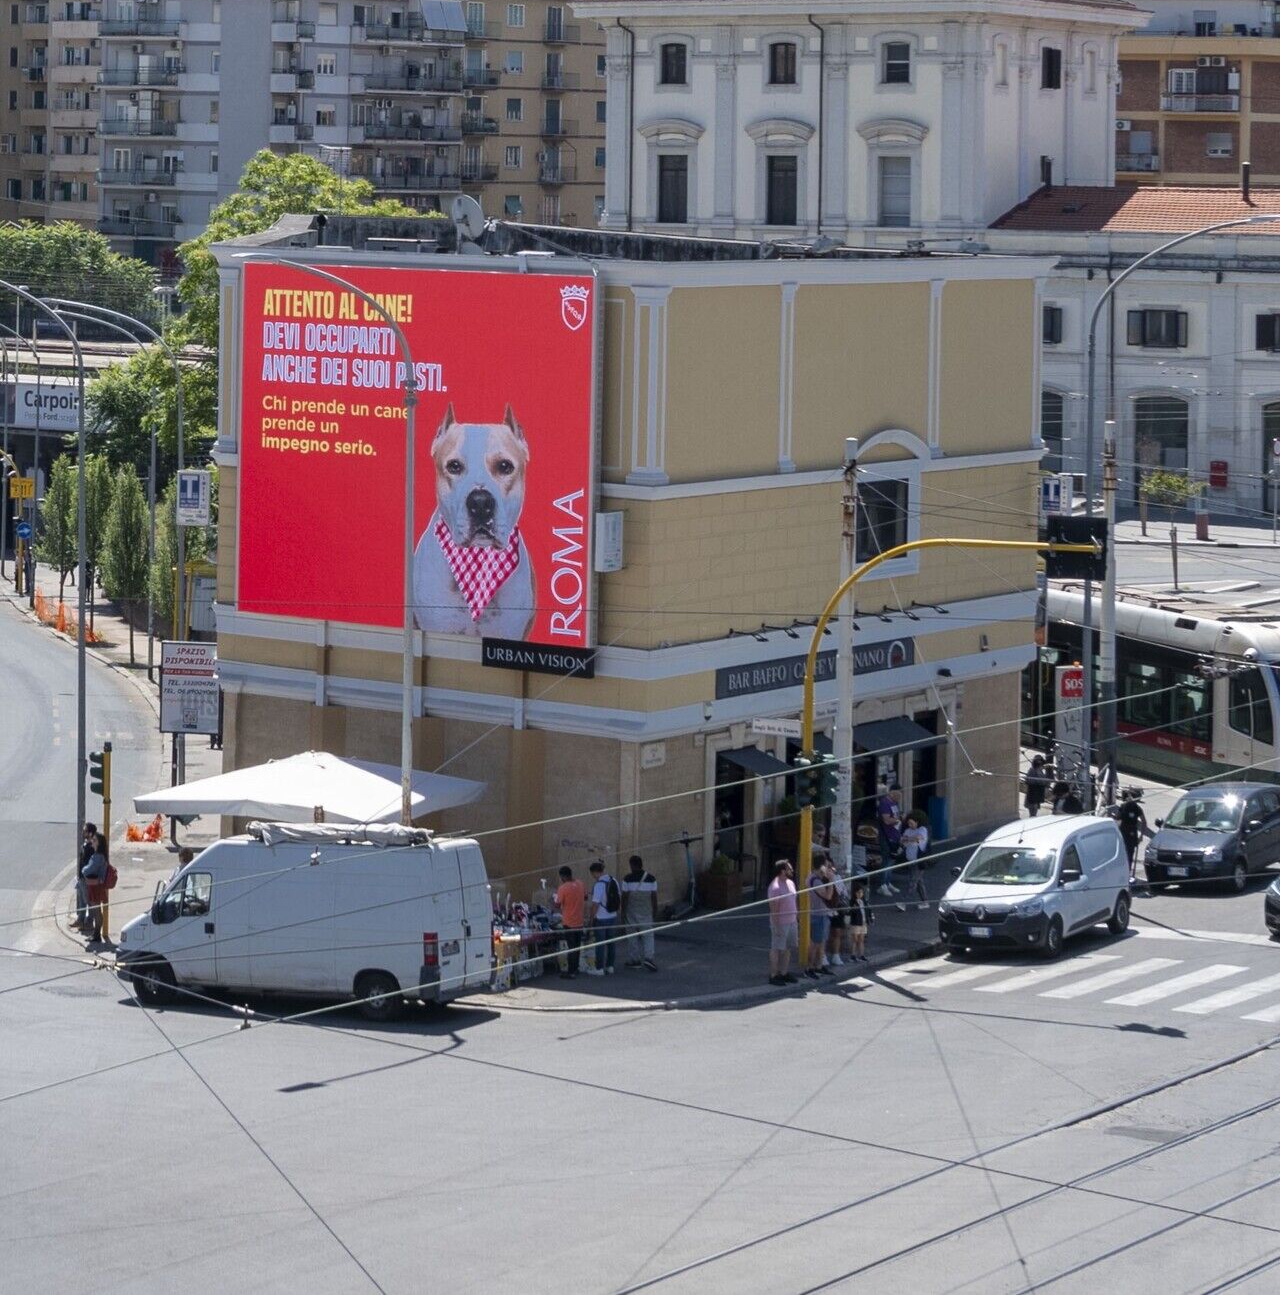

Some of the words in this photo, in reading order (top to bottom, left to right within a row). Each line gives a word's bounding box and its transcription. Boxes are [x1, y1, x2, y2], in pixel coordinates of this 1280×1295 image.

[263, 289, 334, 319] ATTENTO
[339, 292, 359, 320] AL
[363, 293, 413, 322] CANE!
[263, 322, 300, 350] DEVI
[305, 323, 396, 355] OCCUPARTI
[262, 354, 317, 384] ANCHE
[321, 357, 347, 385] DEI
[352, 359, 390, 388] SUOI
[395, 361, 447, 392] PSTI.
[262, 395, 286, 411] Chi
[291, 399, 346, 414] prende
[351, 405, 369, 416] un
[374, 405, 408, 419] cane
[262, 417, 316, 432] prende
[320, 421, 339, 434] un
[261, 433, 330, 453] impegno
[334, 440, 377, 456] serio.
[551, 488, 584, 637] ROMA
[177, 647, 206, 656] SPAZIO
[486, 647, 535, 665] URBAN
[538, 653, 587, 670] VISION
[728, 673, 750, 690] BAR
[753, 666, 787, 686] BAFFO
[1064, 678, 1083, 690] SOS
